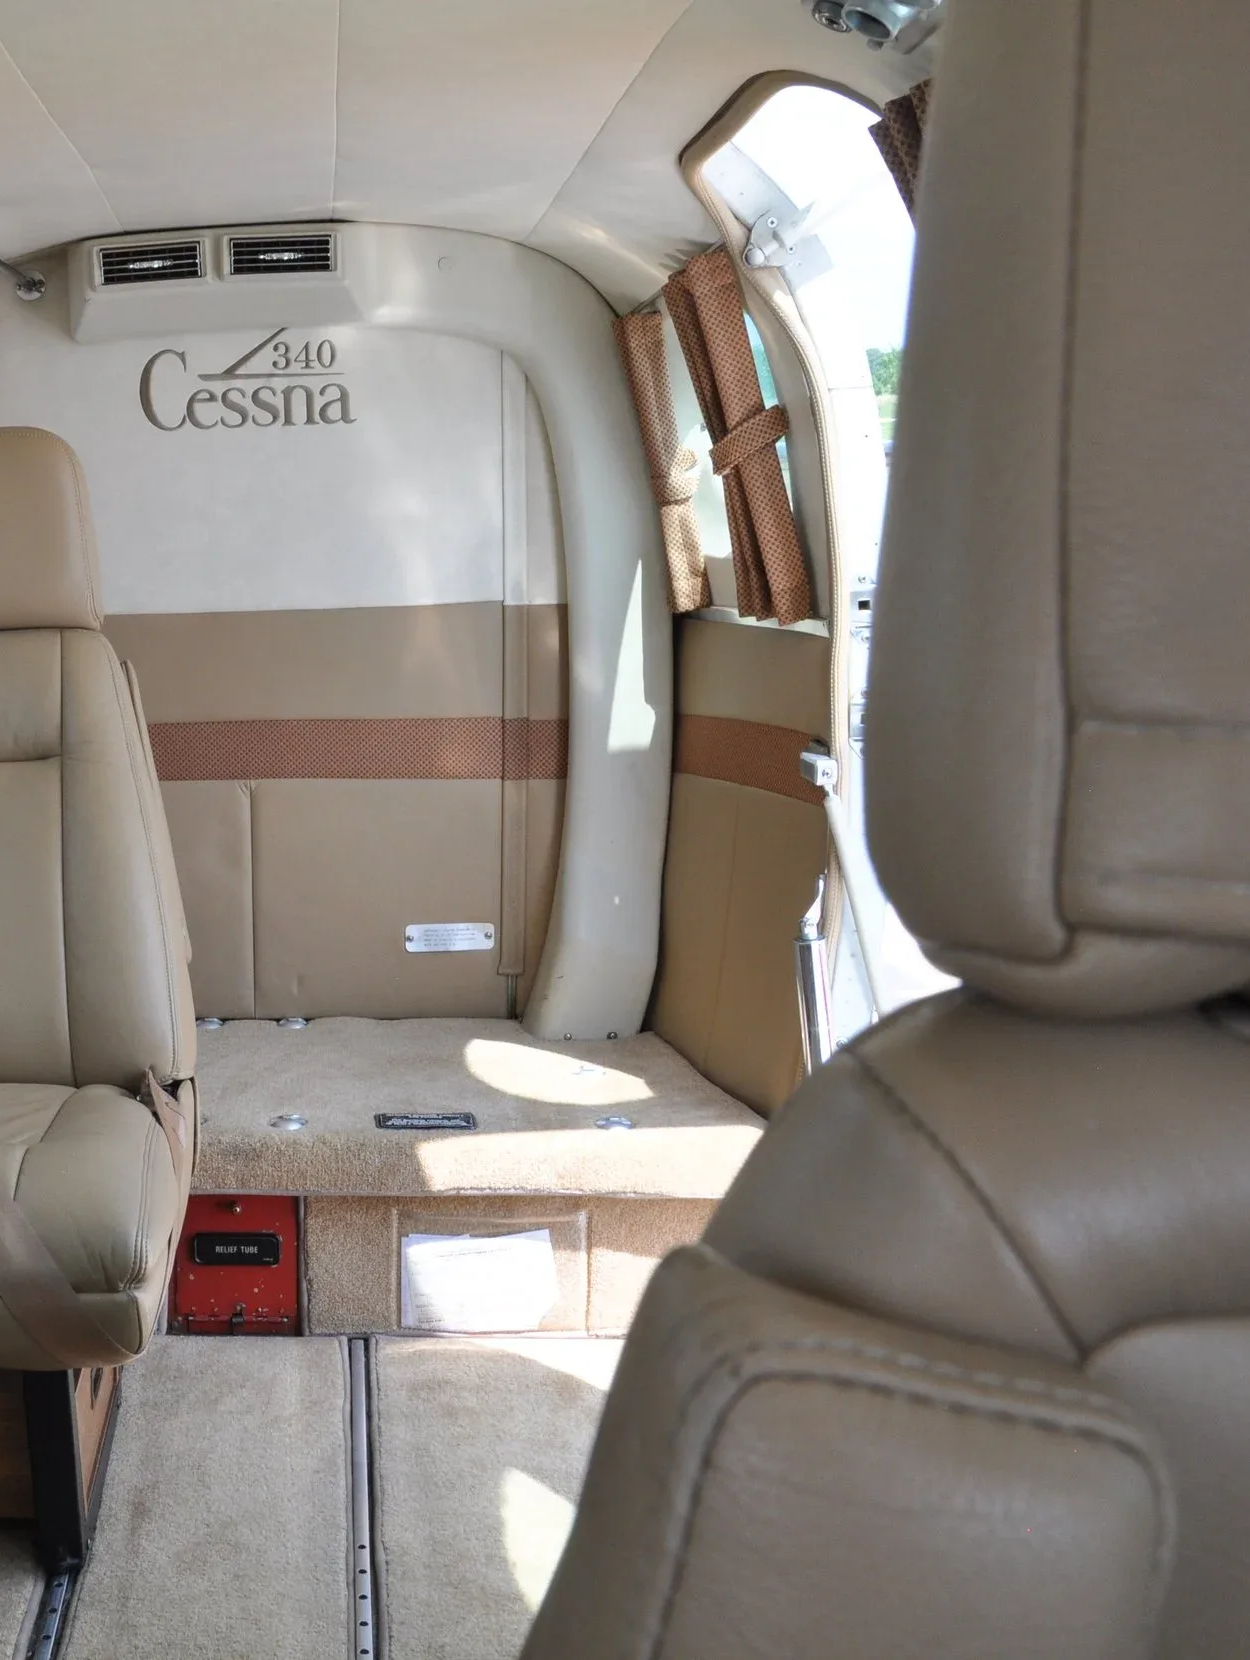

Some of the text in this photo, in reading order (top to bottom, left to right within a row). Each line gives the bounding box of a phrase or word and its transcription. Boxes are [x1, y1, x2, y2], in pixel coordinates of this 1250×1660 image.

[272, 339, 337, 371] 340
[139, 348, 357, 432] Cessna
[215, 1245, 259, 1254] RELIEF TUBE
